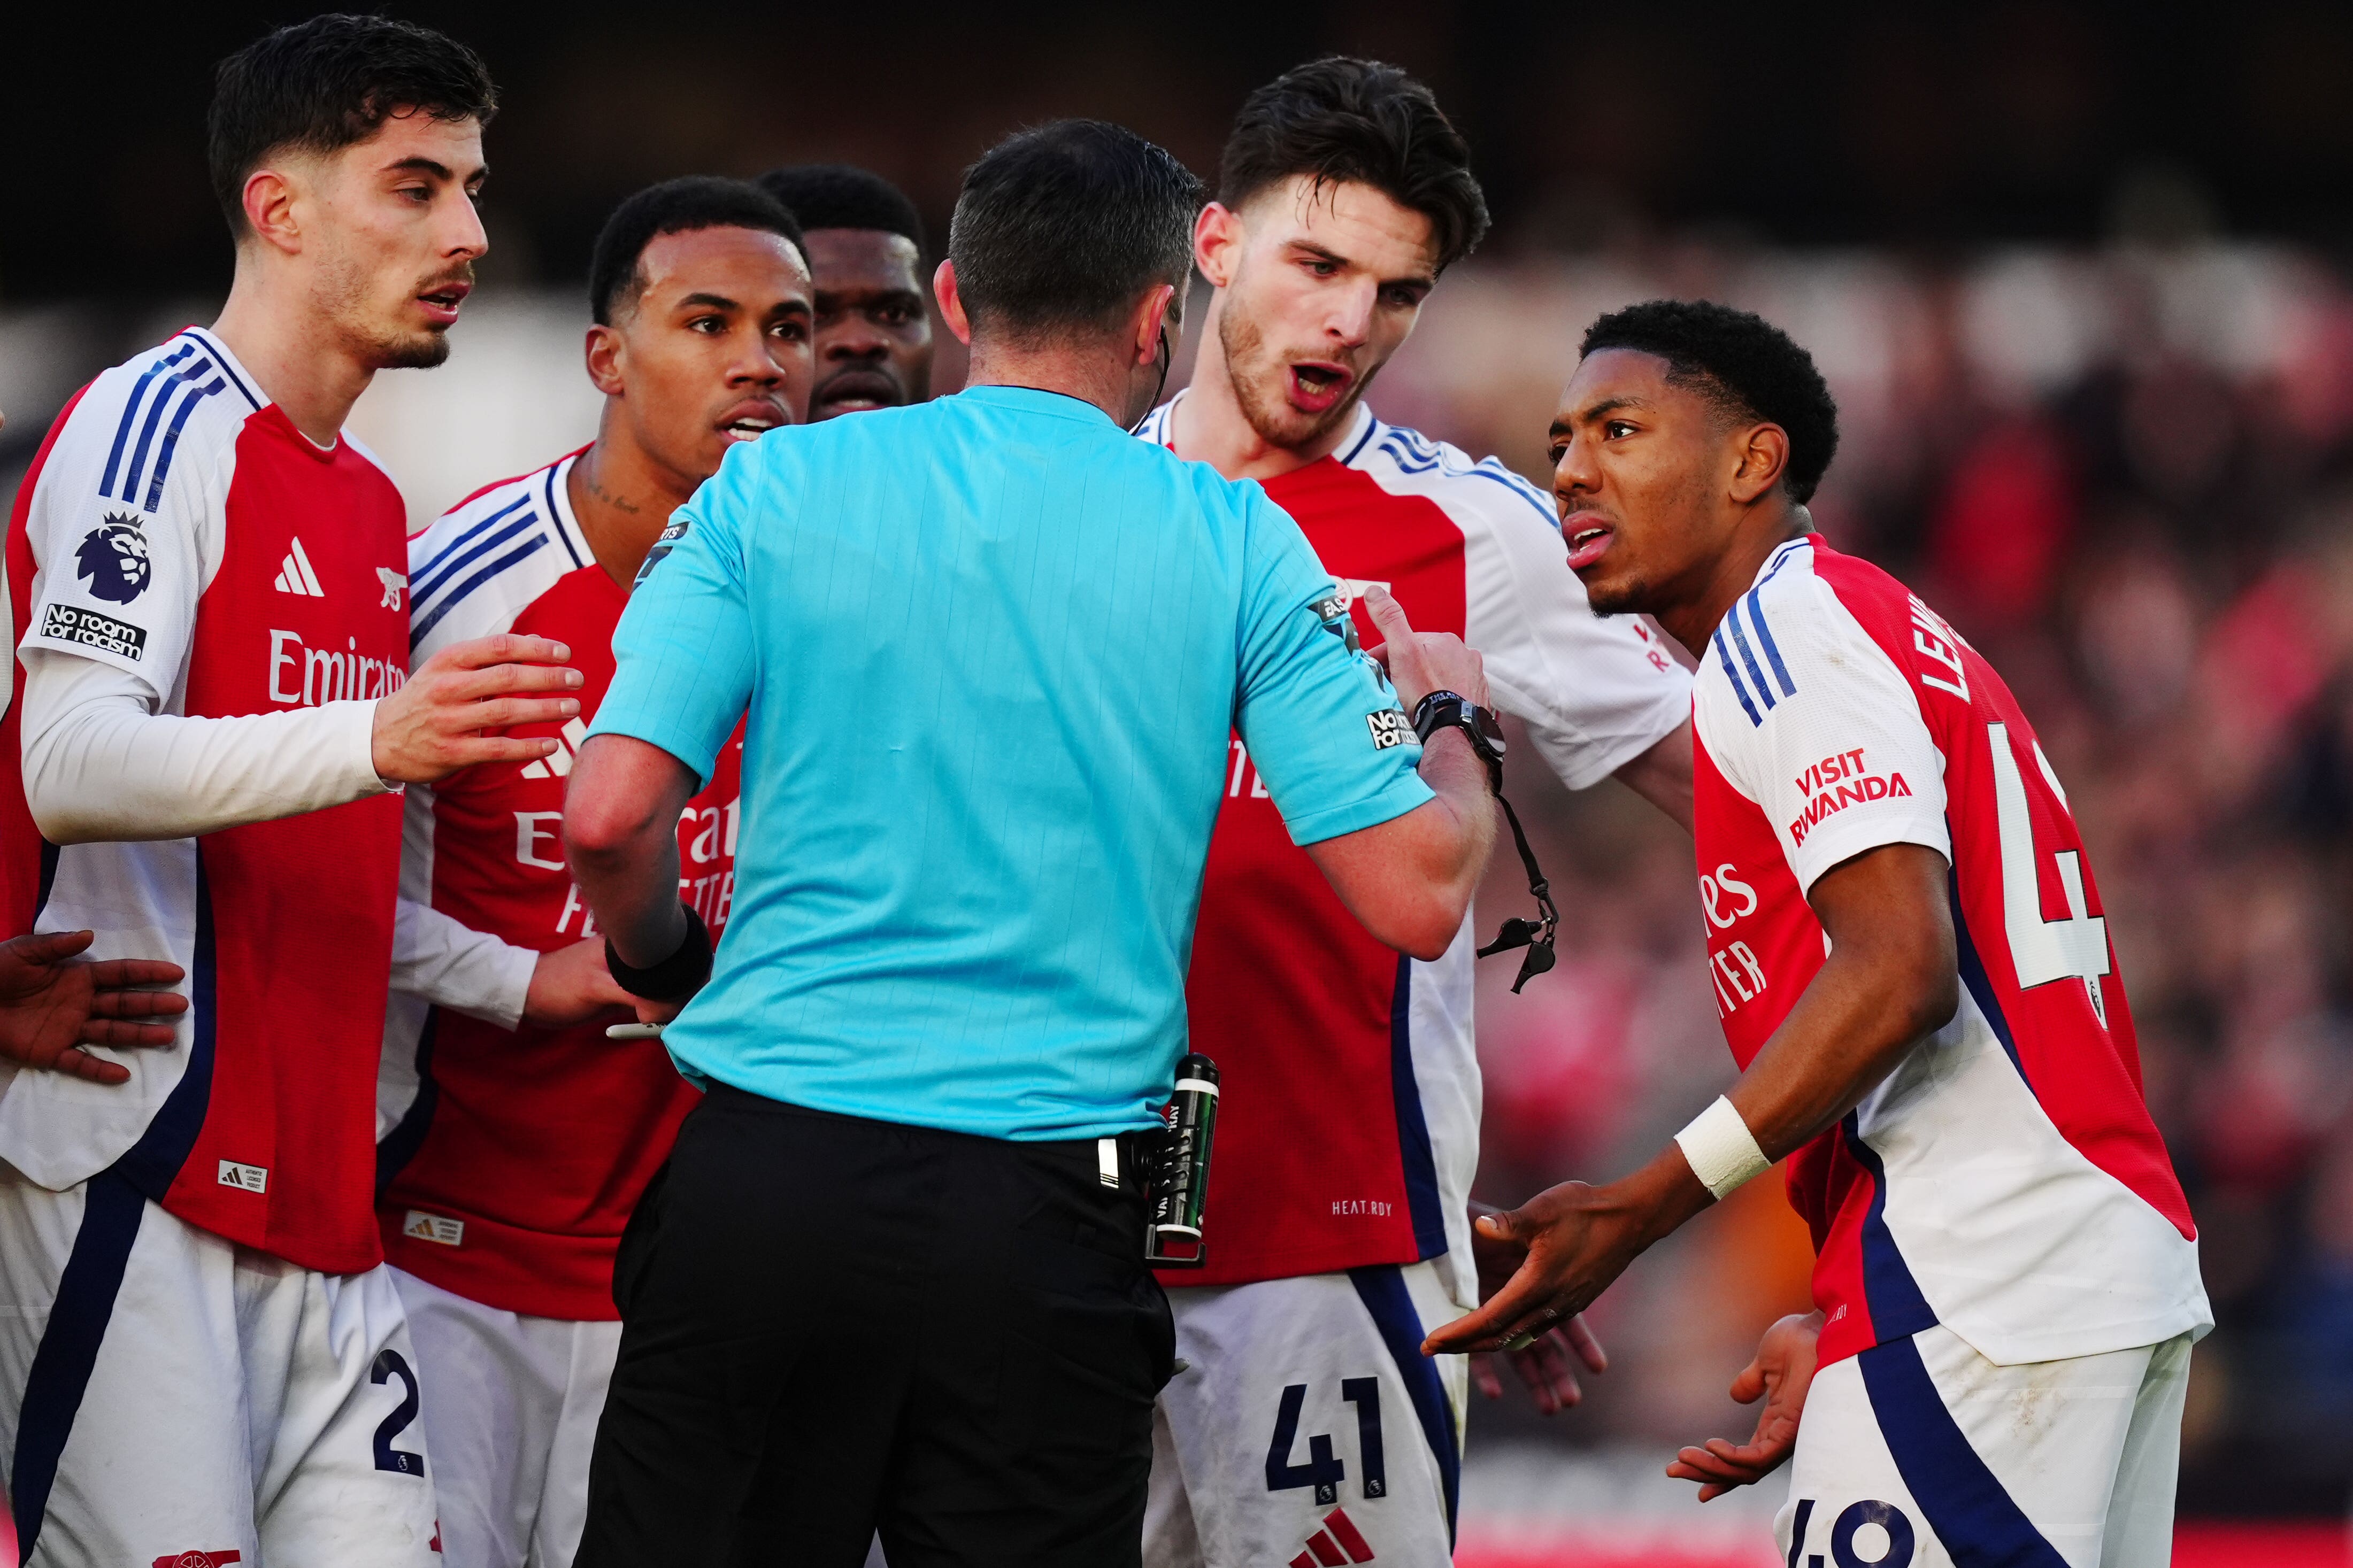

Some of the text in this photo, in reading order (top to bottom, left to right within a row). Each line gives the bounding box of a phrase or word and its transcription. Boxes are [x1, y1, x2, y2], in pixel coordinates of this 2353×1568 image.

[41, 620, 142, 661] for racism
[45, 604, 136, 643] No room
[269, 628, 407, 706] Emirate
[1366, 710, 1397, 731] No
[1372, 729, 1401, 750] for
[1795, 747, 1865, 798] VISIT
[1789, 772, 1913, 848] RWANDA
[1332, 1200, 1391, 1217] HEAT.RDY
[370, 1349, 425, 1478] 2
[1265, 1376, 1387, 1507] 41
